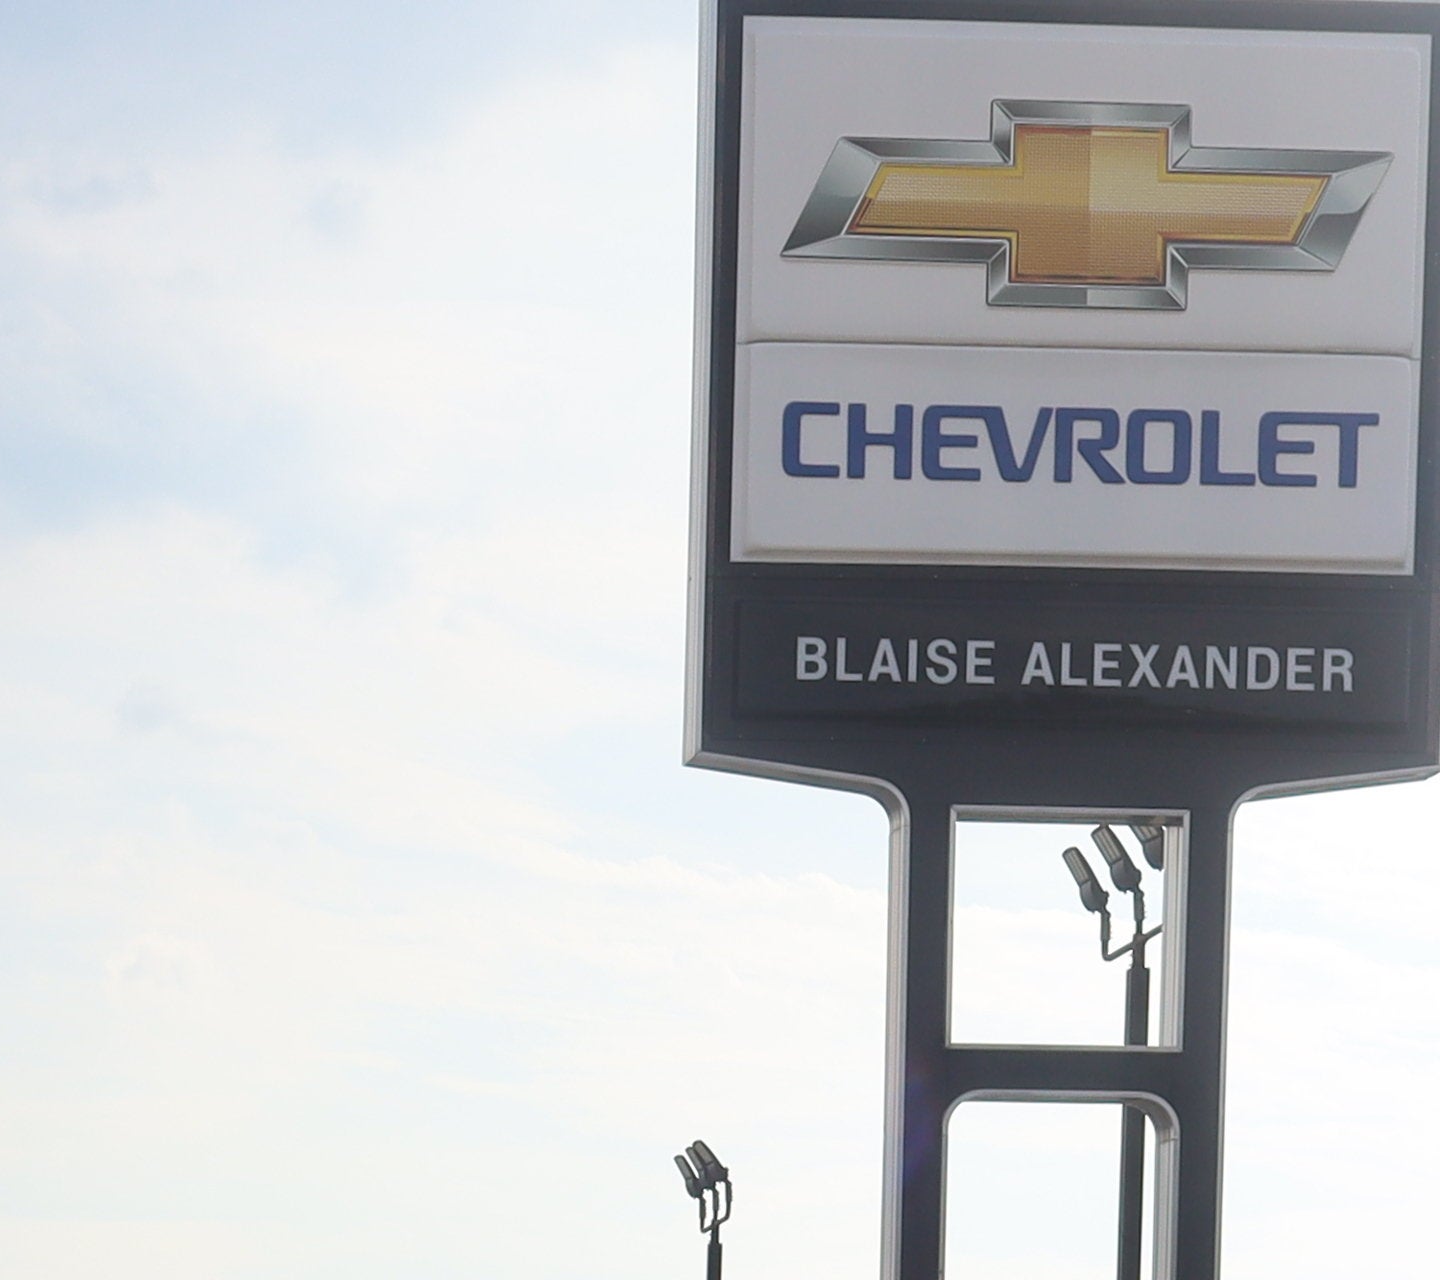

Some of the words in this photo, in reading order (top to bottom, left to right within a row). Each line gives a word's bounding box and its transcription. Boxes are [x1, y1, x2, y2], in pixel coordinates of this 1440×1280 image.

[782, 401, 1380, 488] CHEVROLET
[795, 636, 996, 685] BLAISE
[1021, 641, 1354, 692] ALEXANDER
